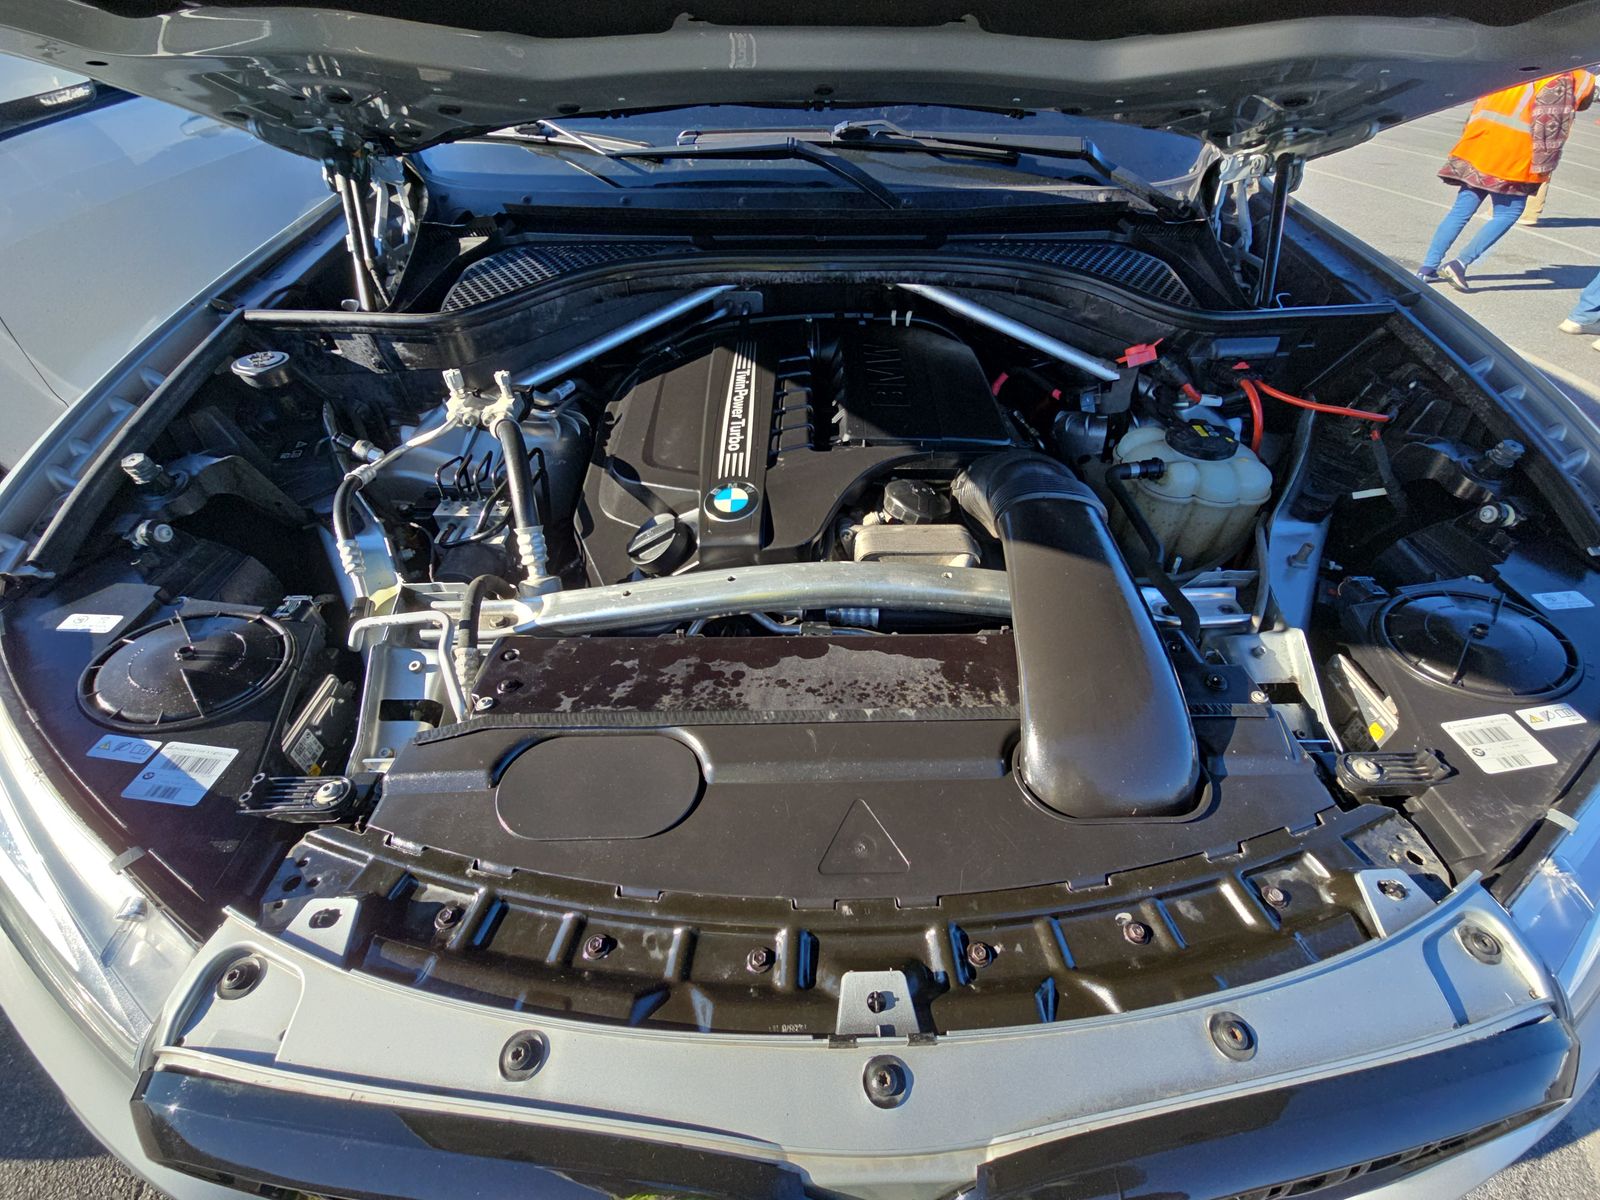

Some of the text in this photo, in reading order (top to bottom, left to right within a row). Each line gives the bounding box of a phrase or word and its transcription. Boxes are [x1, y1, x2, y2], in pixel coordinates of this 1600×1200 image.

[728, 368, 750, 452] TwinPower Turbo
[710, 482, 755, 496] BMW
